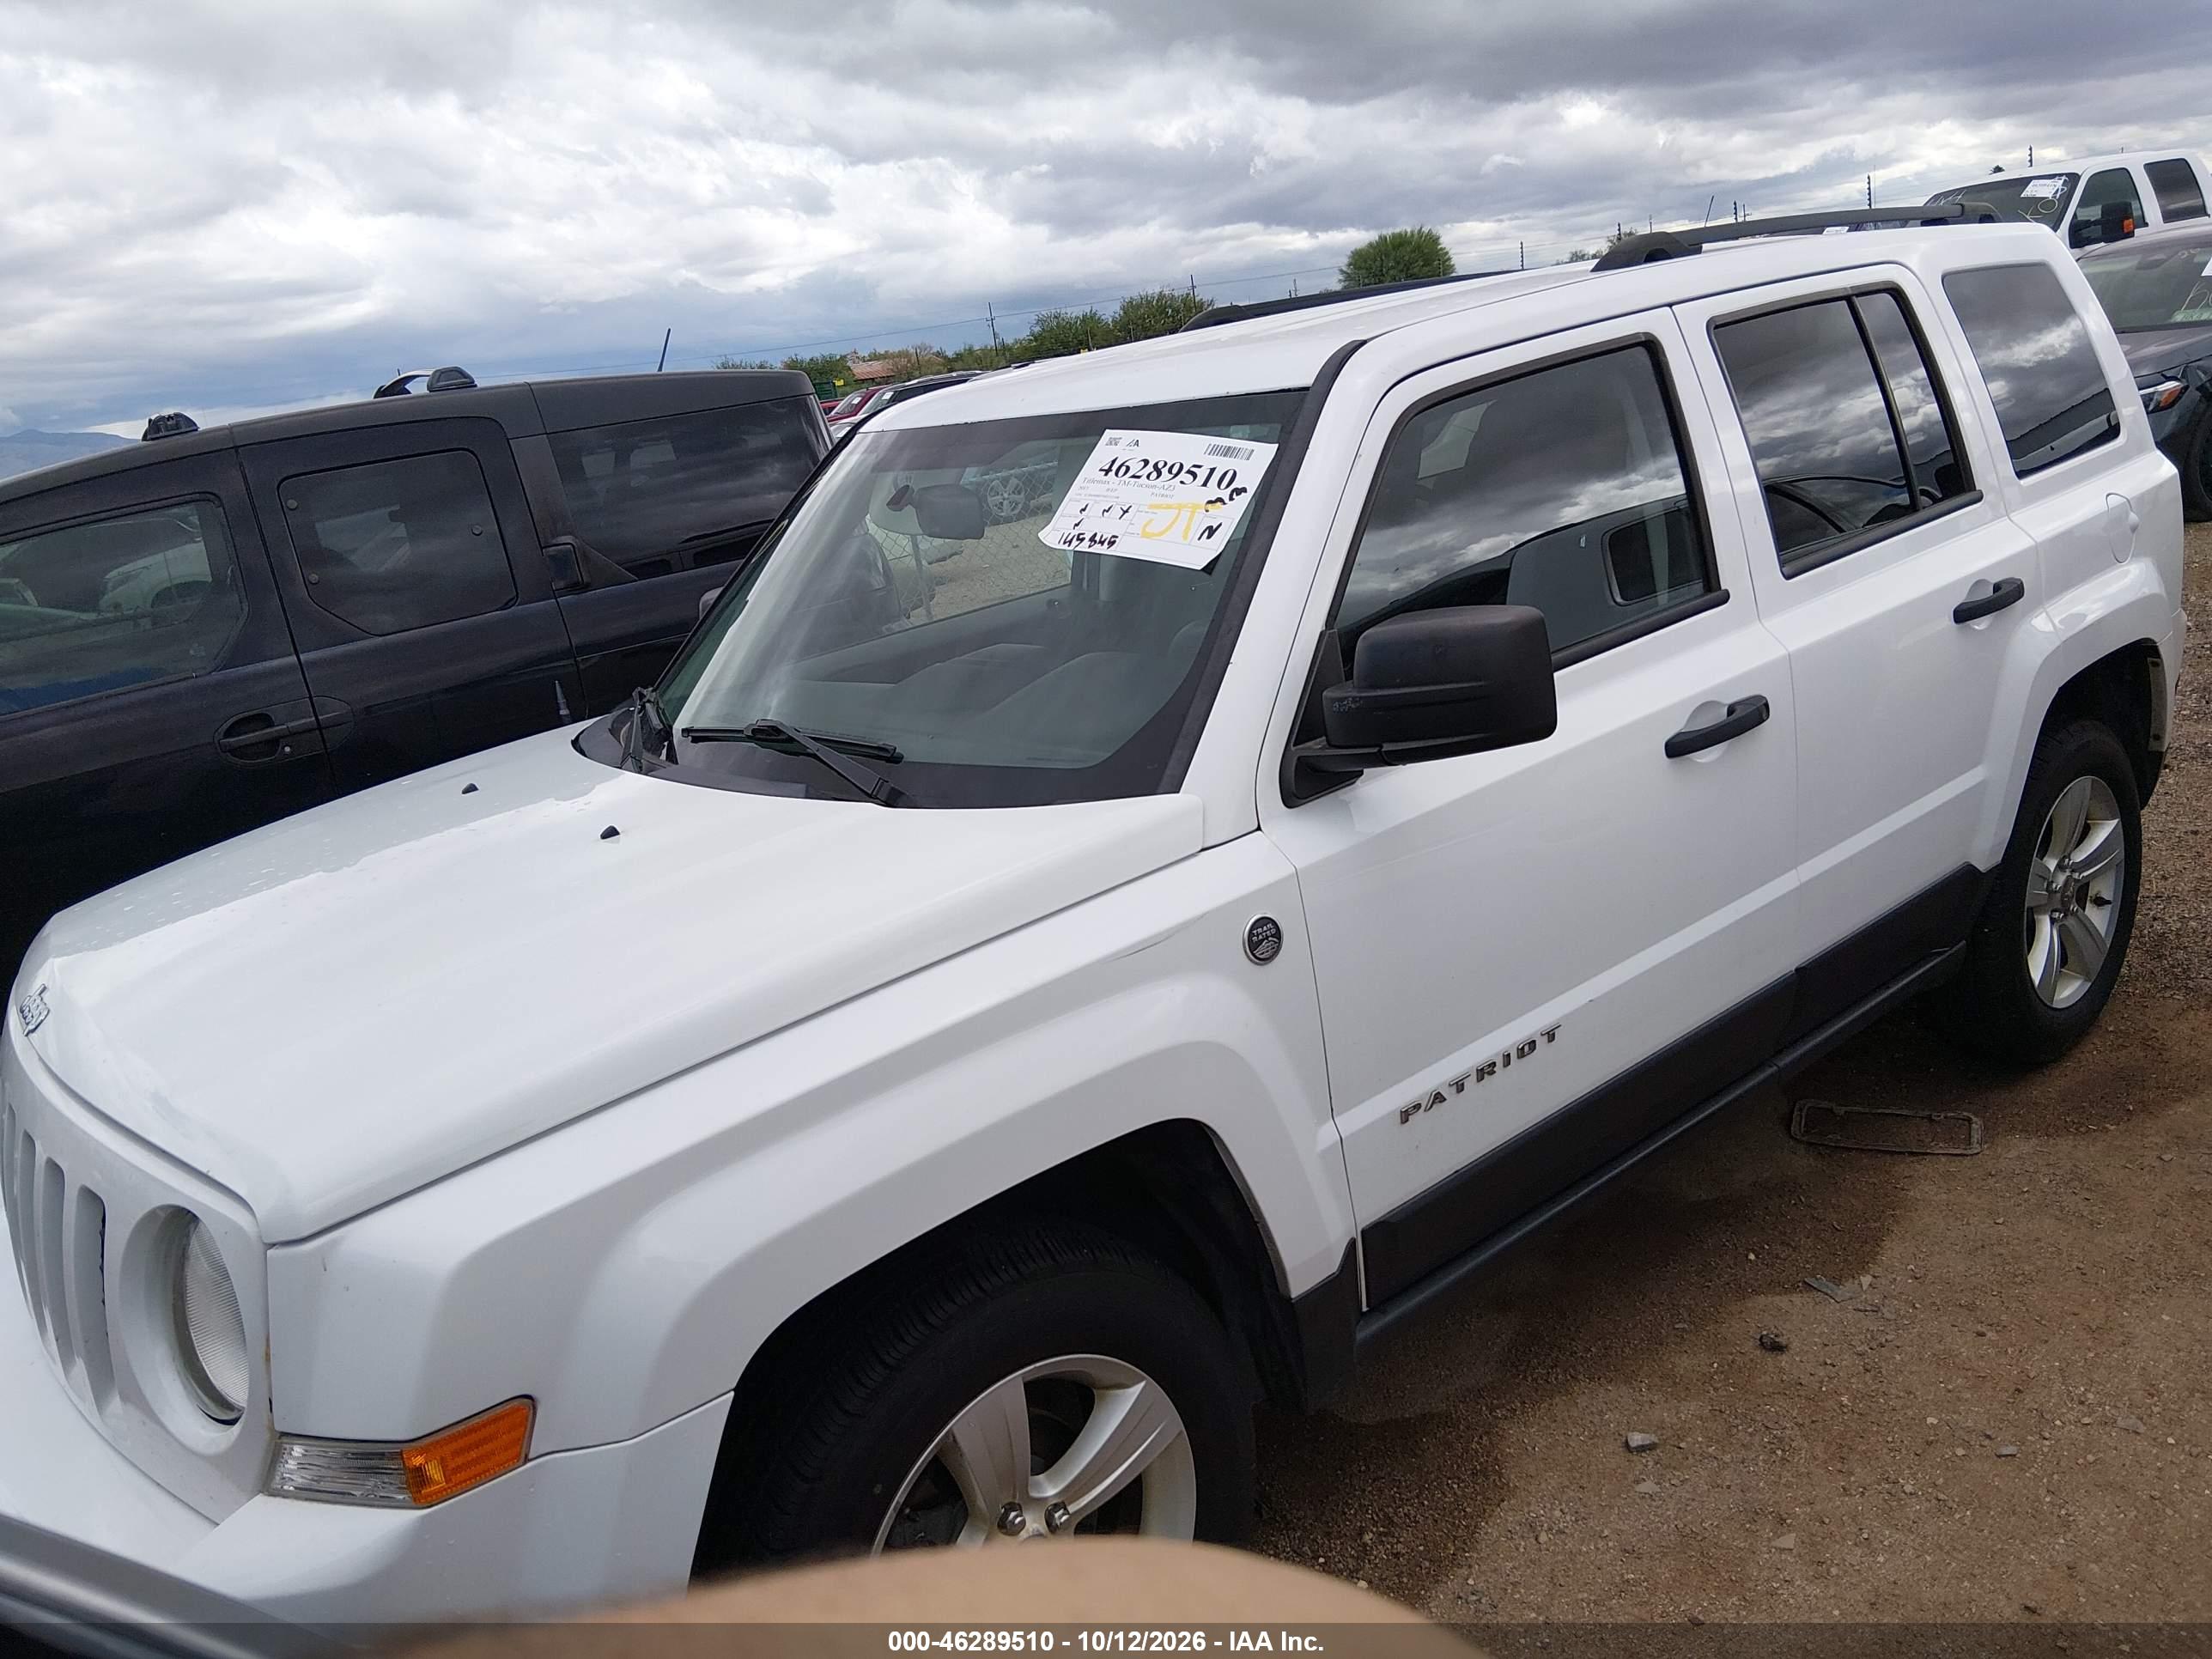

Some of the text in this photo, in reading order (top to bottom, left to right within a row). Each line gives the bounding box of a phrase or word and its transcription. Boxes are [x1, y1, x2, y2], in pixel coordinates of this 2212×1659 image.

[1098, 456, 1238, 490] 46289510
[1252, 923, 1274, 936] TRAIL
[1252, 928, 1277, 943] RATED
[1400, 1022, 1562, 1125] PATRIOT
